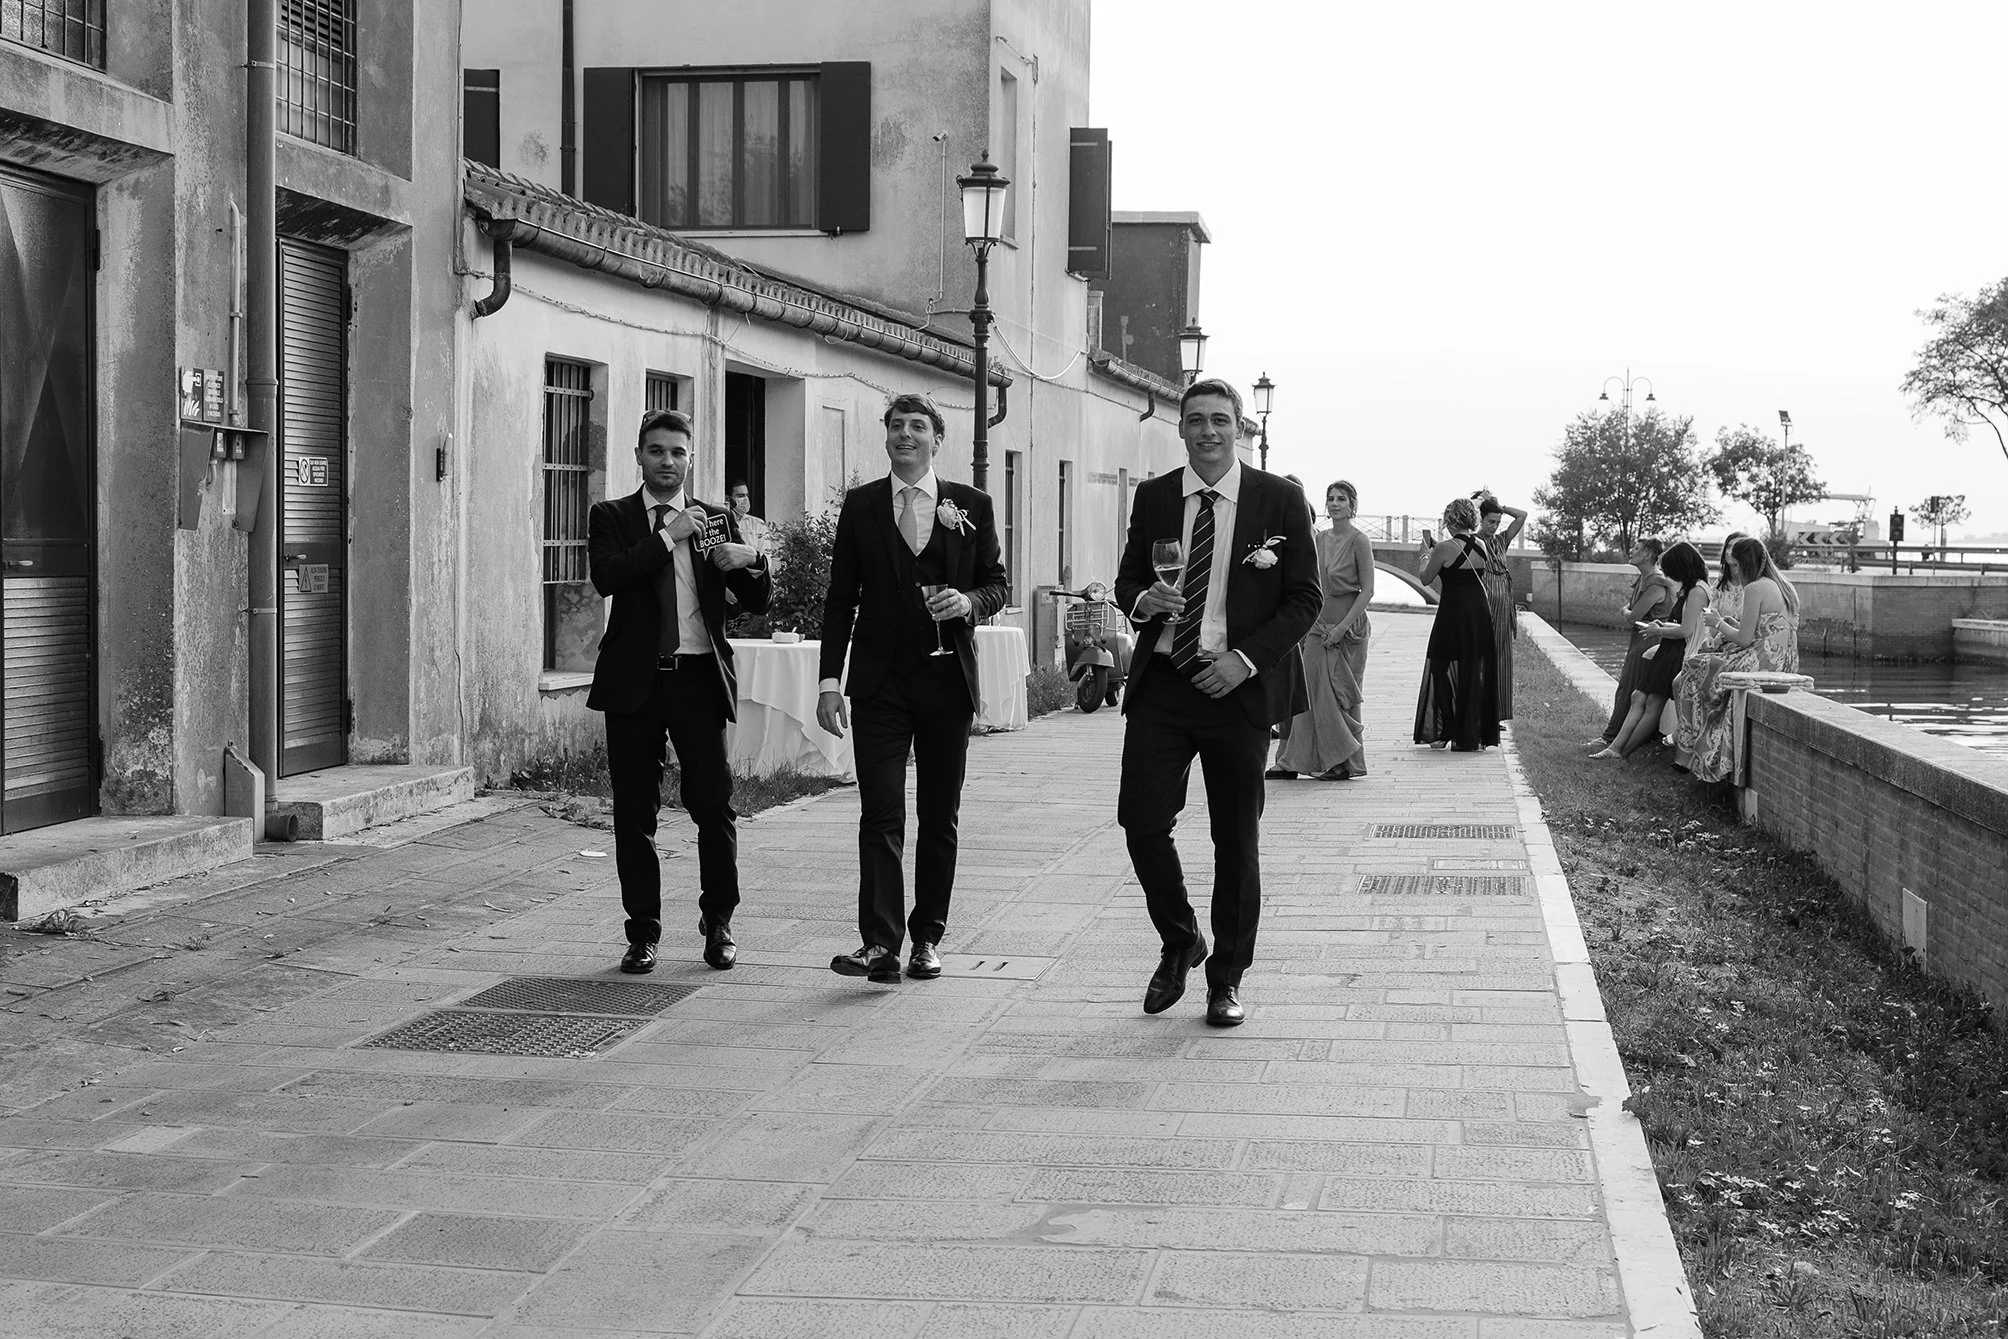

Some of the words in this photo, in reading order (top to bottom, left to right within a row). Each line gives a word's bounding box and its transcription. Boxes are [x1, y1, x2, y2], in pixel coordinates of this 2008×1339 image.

[708, 518, 724, 528] here
[708, 528, 720, 537] the
[699, 533, 727, 548] BOOZE!
